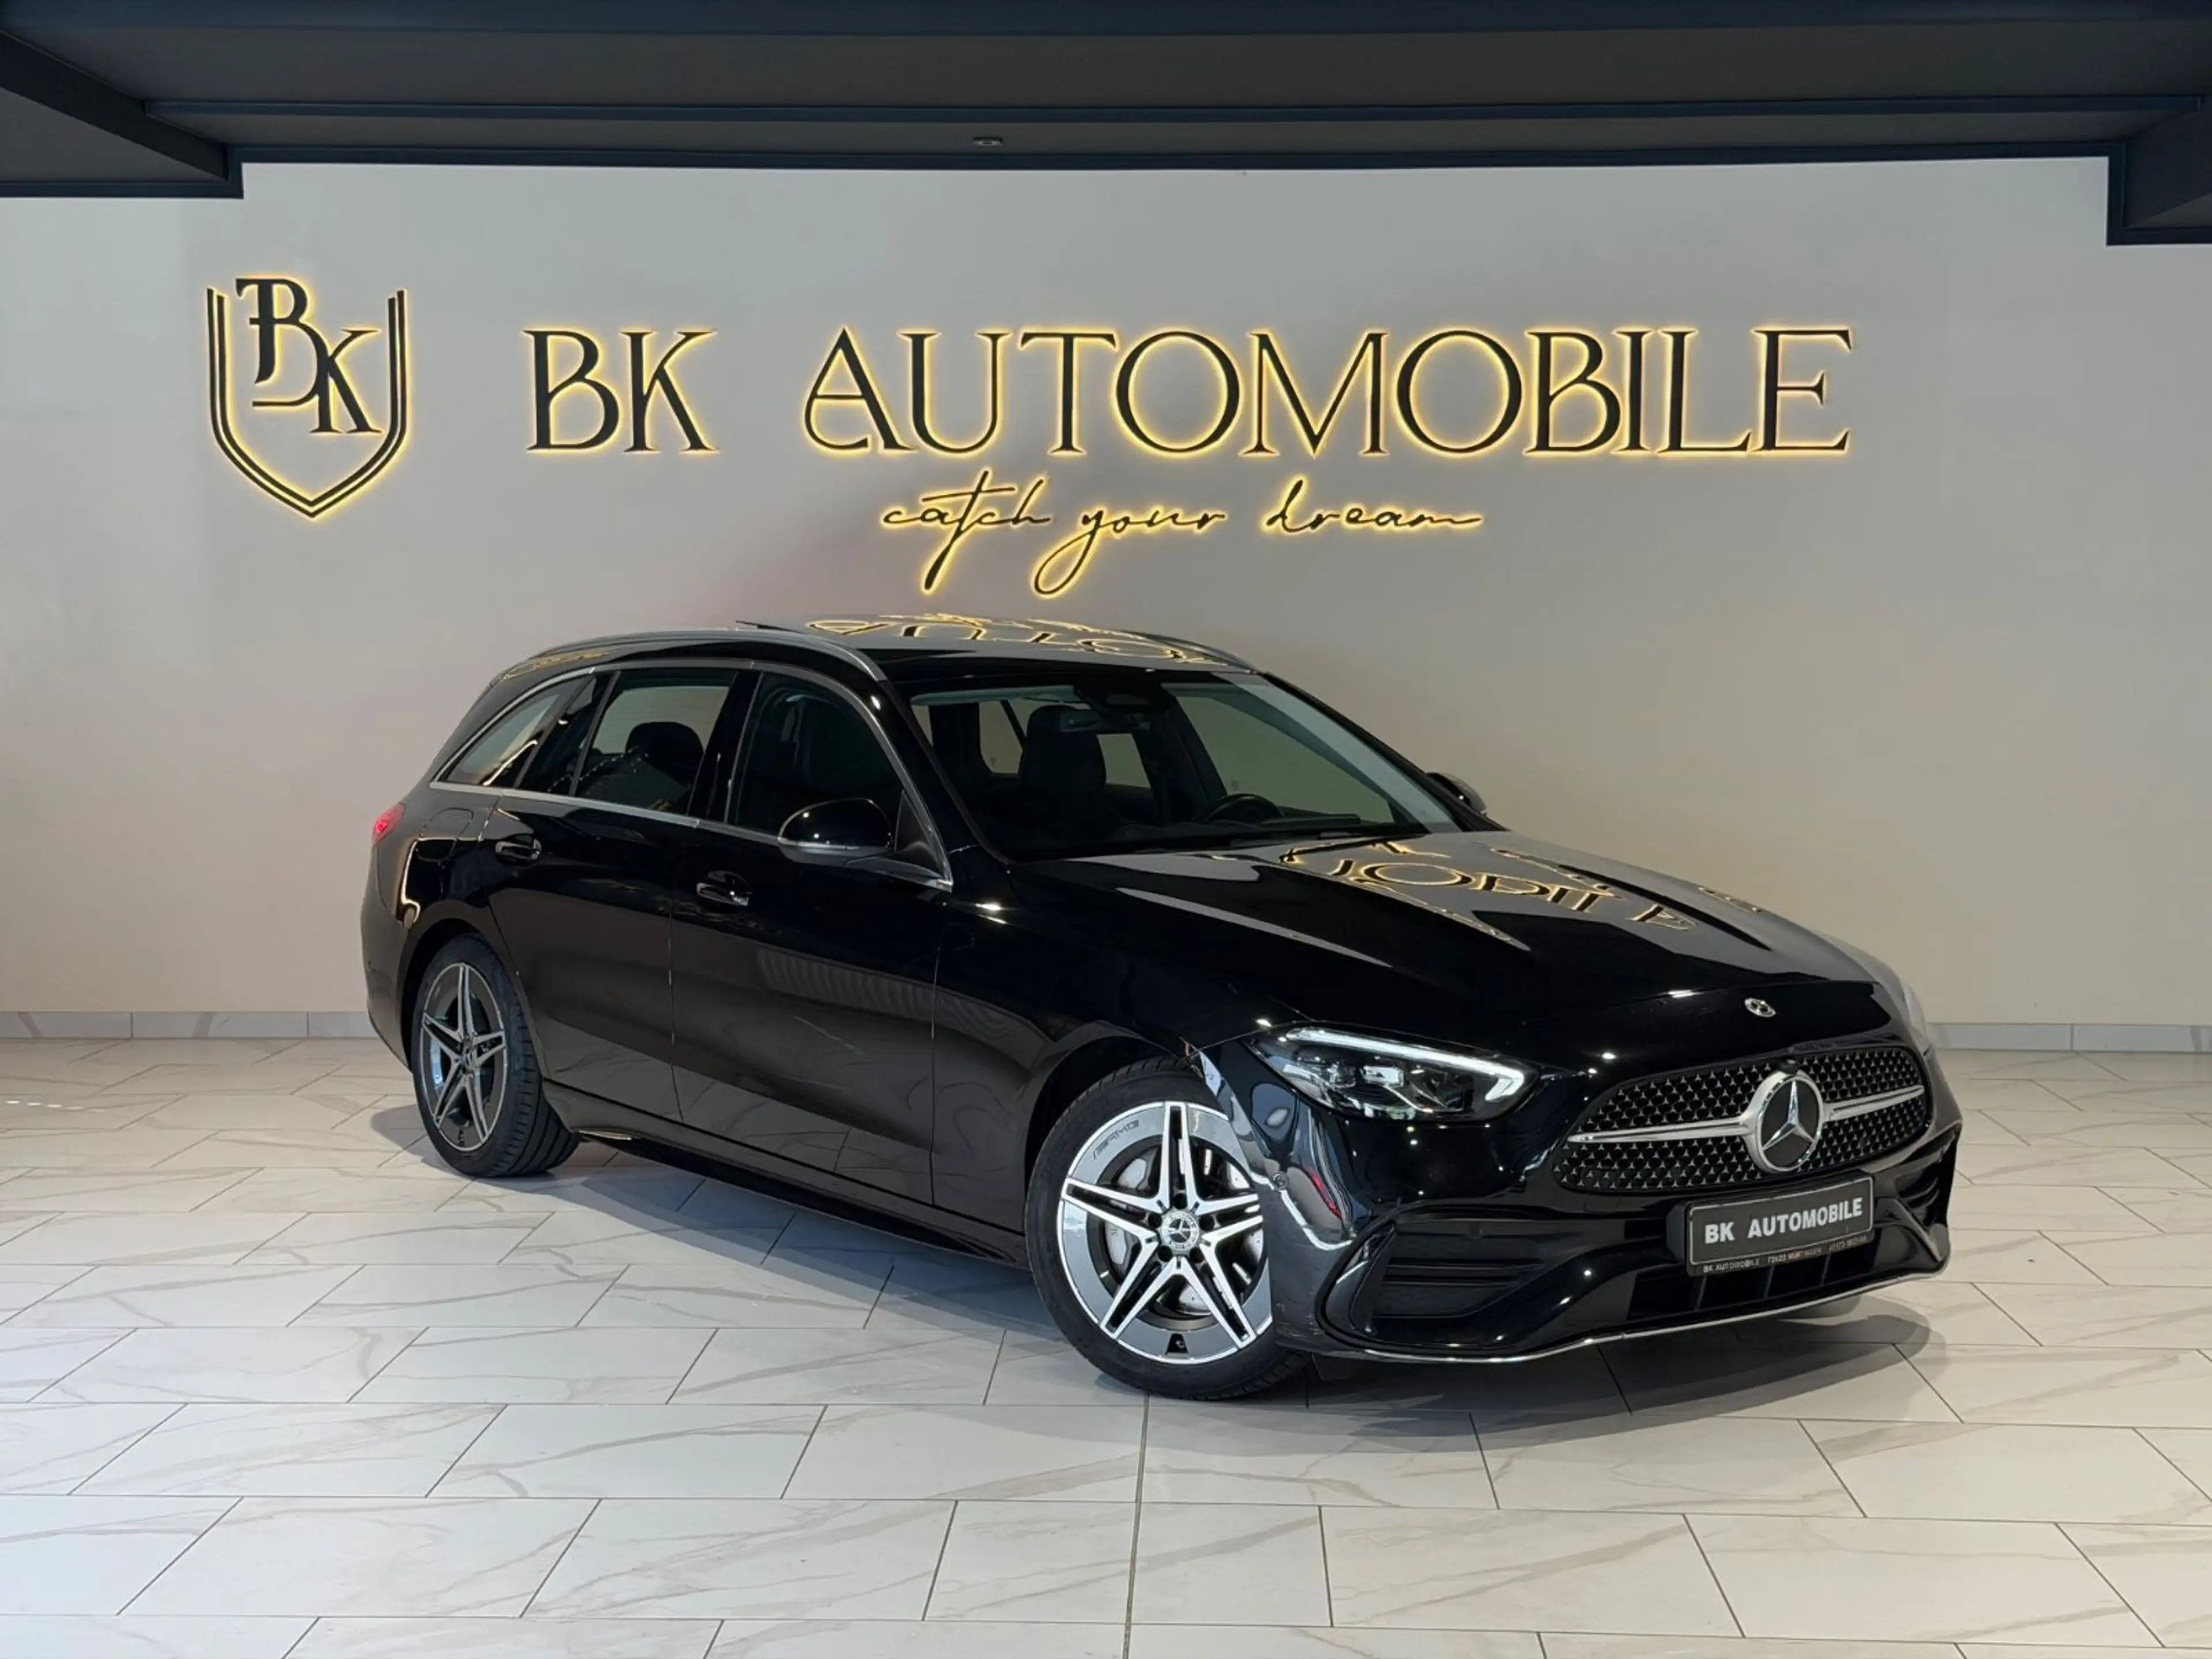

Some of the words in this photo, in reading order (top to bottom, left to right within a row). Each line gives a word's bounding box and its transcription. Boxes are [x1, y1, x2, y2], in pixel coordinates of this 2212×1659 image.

[523, 329, 720, 452] BK
[805, 328, 1851, 456] AUTOMOBILE
[882, 470, 1051, 590] catch
[1033, 509, 1225, 595] your
[1266, 479, 1482, 533] dream
[1704, 1221, 1735, 1244] BK
[1748, 1197, 1863, 1239] AUTOMOBILE
